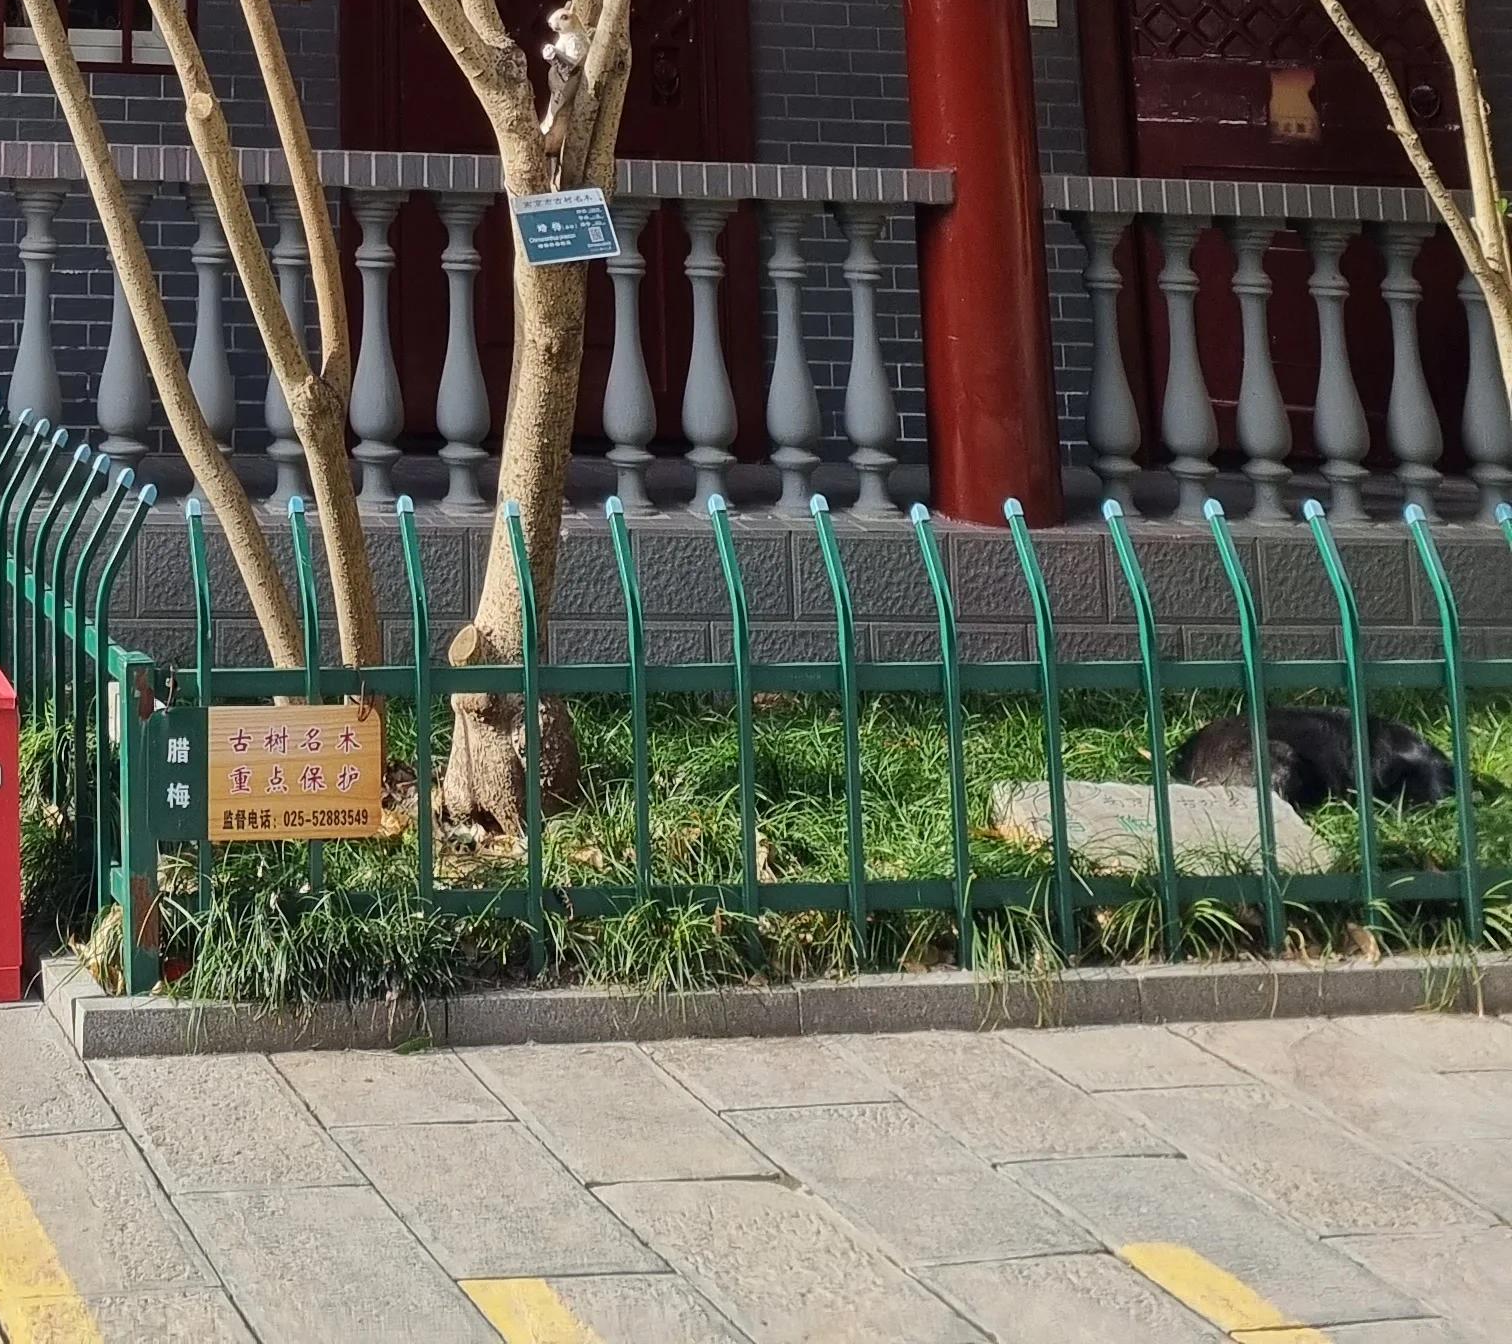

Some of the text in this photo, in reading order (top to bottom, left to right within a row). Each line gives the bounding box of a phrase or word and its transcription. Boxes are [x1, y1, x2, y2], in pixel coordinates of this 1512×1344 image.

[228, 725, 361, 755] 古树名木
[166, 737, 191, 809] 腊梅
[228, 765, 361, 794] 重点保护
